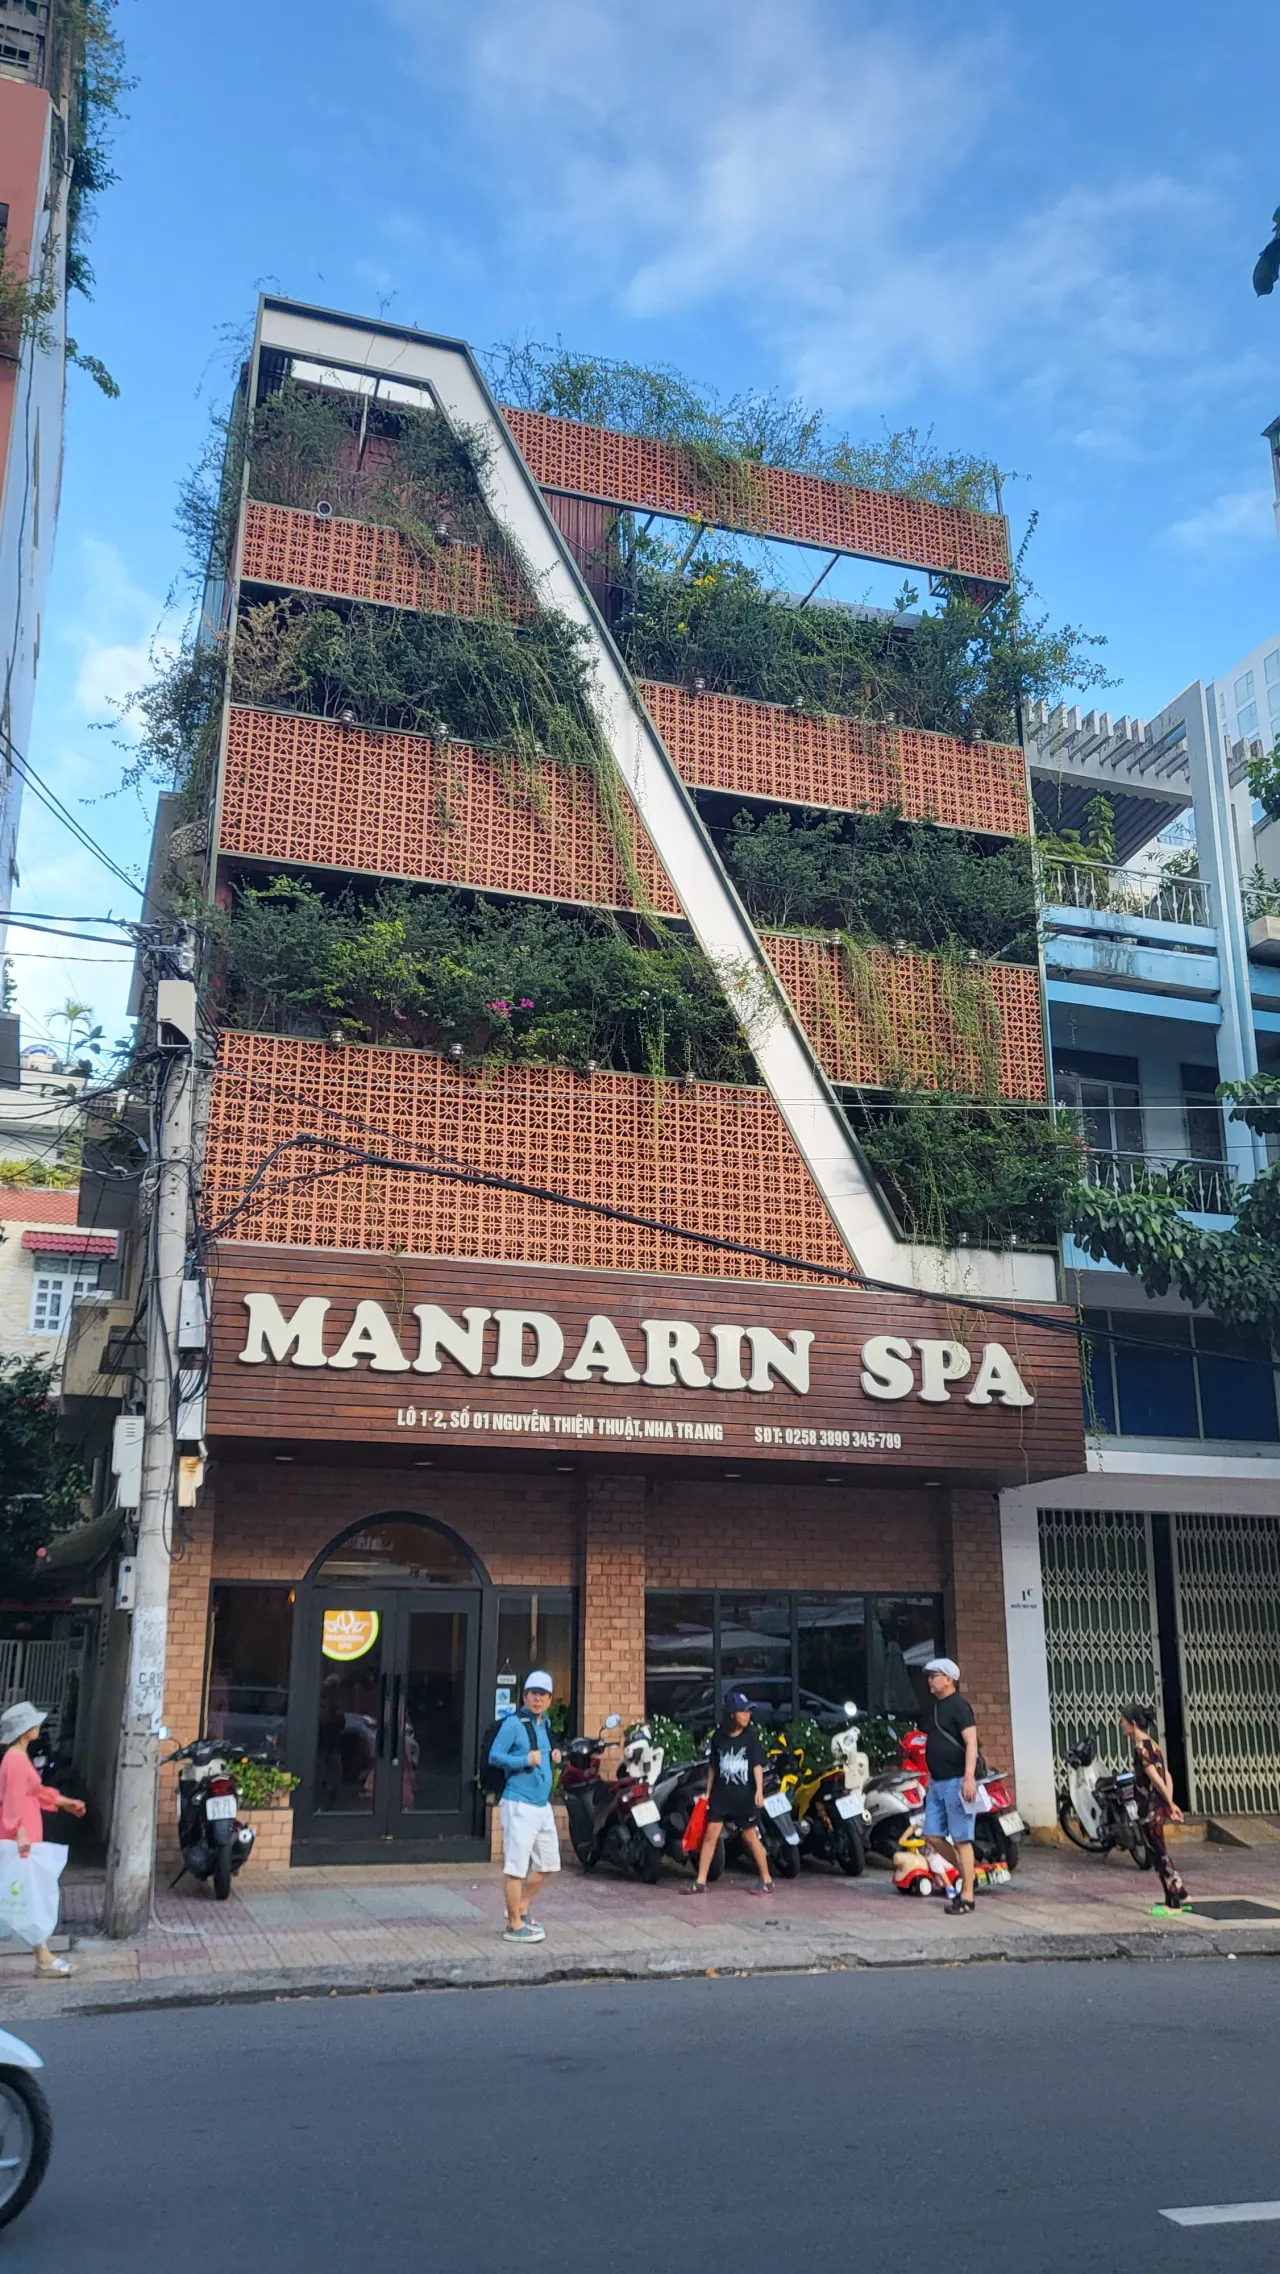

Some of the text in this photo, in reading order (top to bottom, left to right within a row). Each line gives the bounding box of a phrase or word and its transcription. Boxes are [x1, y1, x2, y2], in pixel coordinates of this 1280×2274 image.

[238, 1292, 1036, 1407] MANDARIN SPA
[397, 1405, 417, 1427] LÔ
[420, 1410, 447, 1430] 1-2,
[449, 1405, 471, 1429] SỐ
[473, 1412, 490, 1430] 01
[492, 1408, 550, 1433] NGUYỄN
[553, 1413, 595, 1439] THIỆN
[676, 1422, 724, 1441] TRANG
[754, 1426, 902, 1449] SĐT: 0258 3899 345-789
